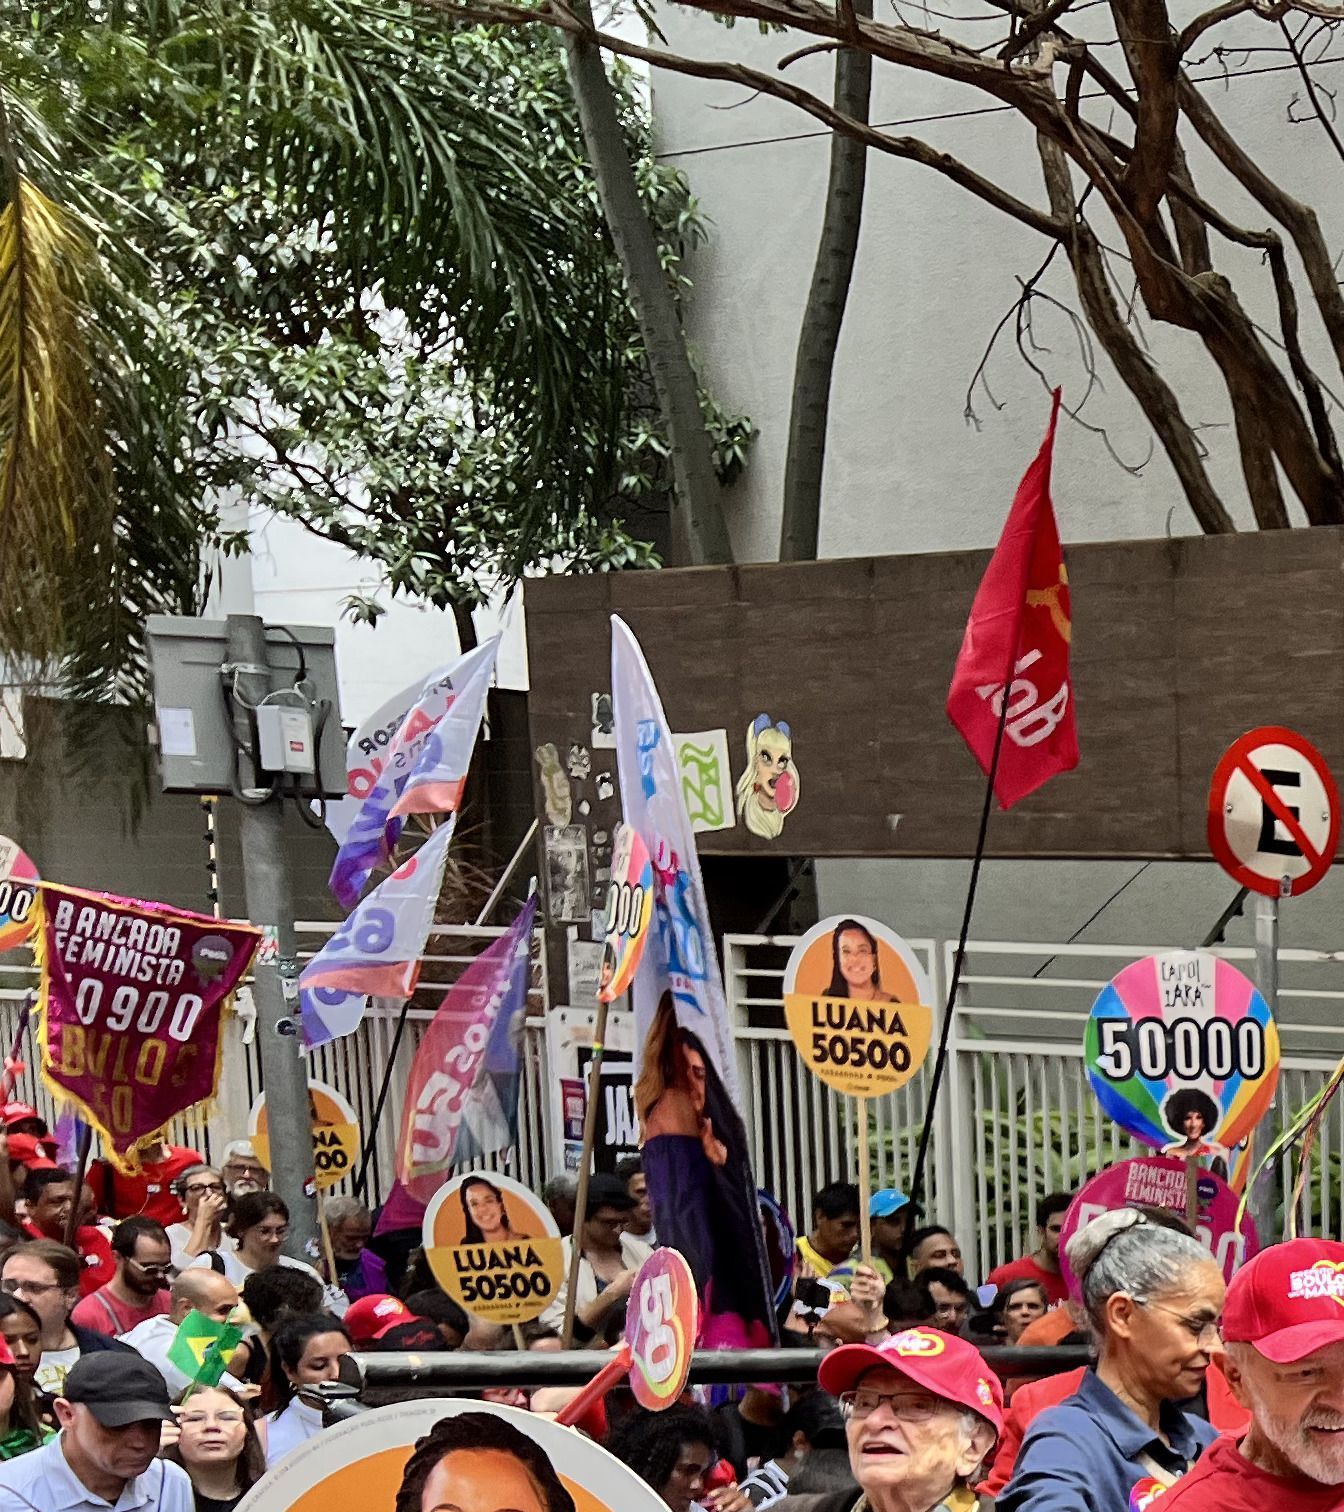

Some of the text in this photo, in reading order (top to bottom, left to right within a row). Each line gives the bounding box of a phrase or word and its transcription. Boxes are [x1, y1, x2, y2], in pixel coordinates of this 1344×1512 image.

[54, 900, 181, 956] BANCADA
[55, 929, 185, 986] FEMINISTA
[64, 972, 203, 1042] 0900
[812, 1001, 909, 1037] LUANA
[812, 1033, 911, 1073] 50500
[1099, 1018, 1264, 1080] 50000
[453, 1245, 545, 1273] LUANA
[460, 1271, 551, 1302] 50500
[639, 1273, 678, 1383] 50
